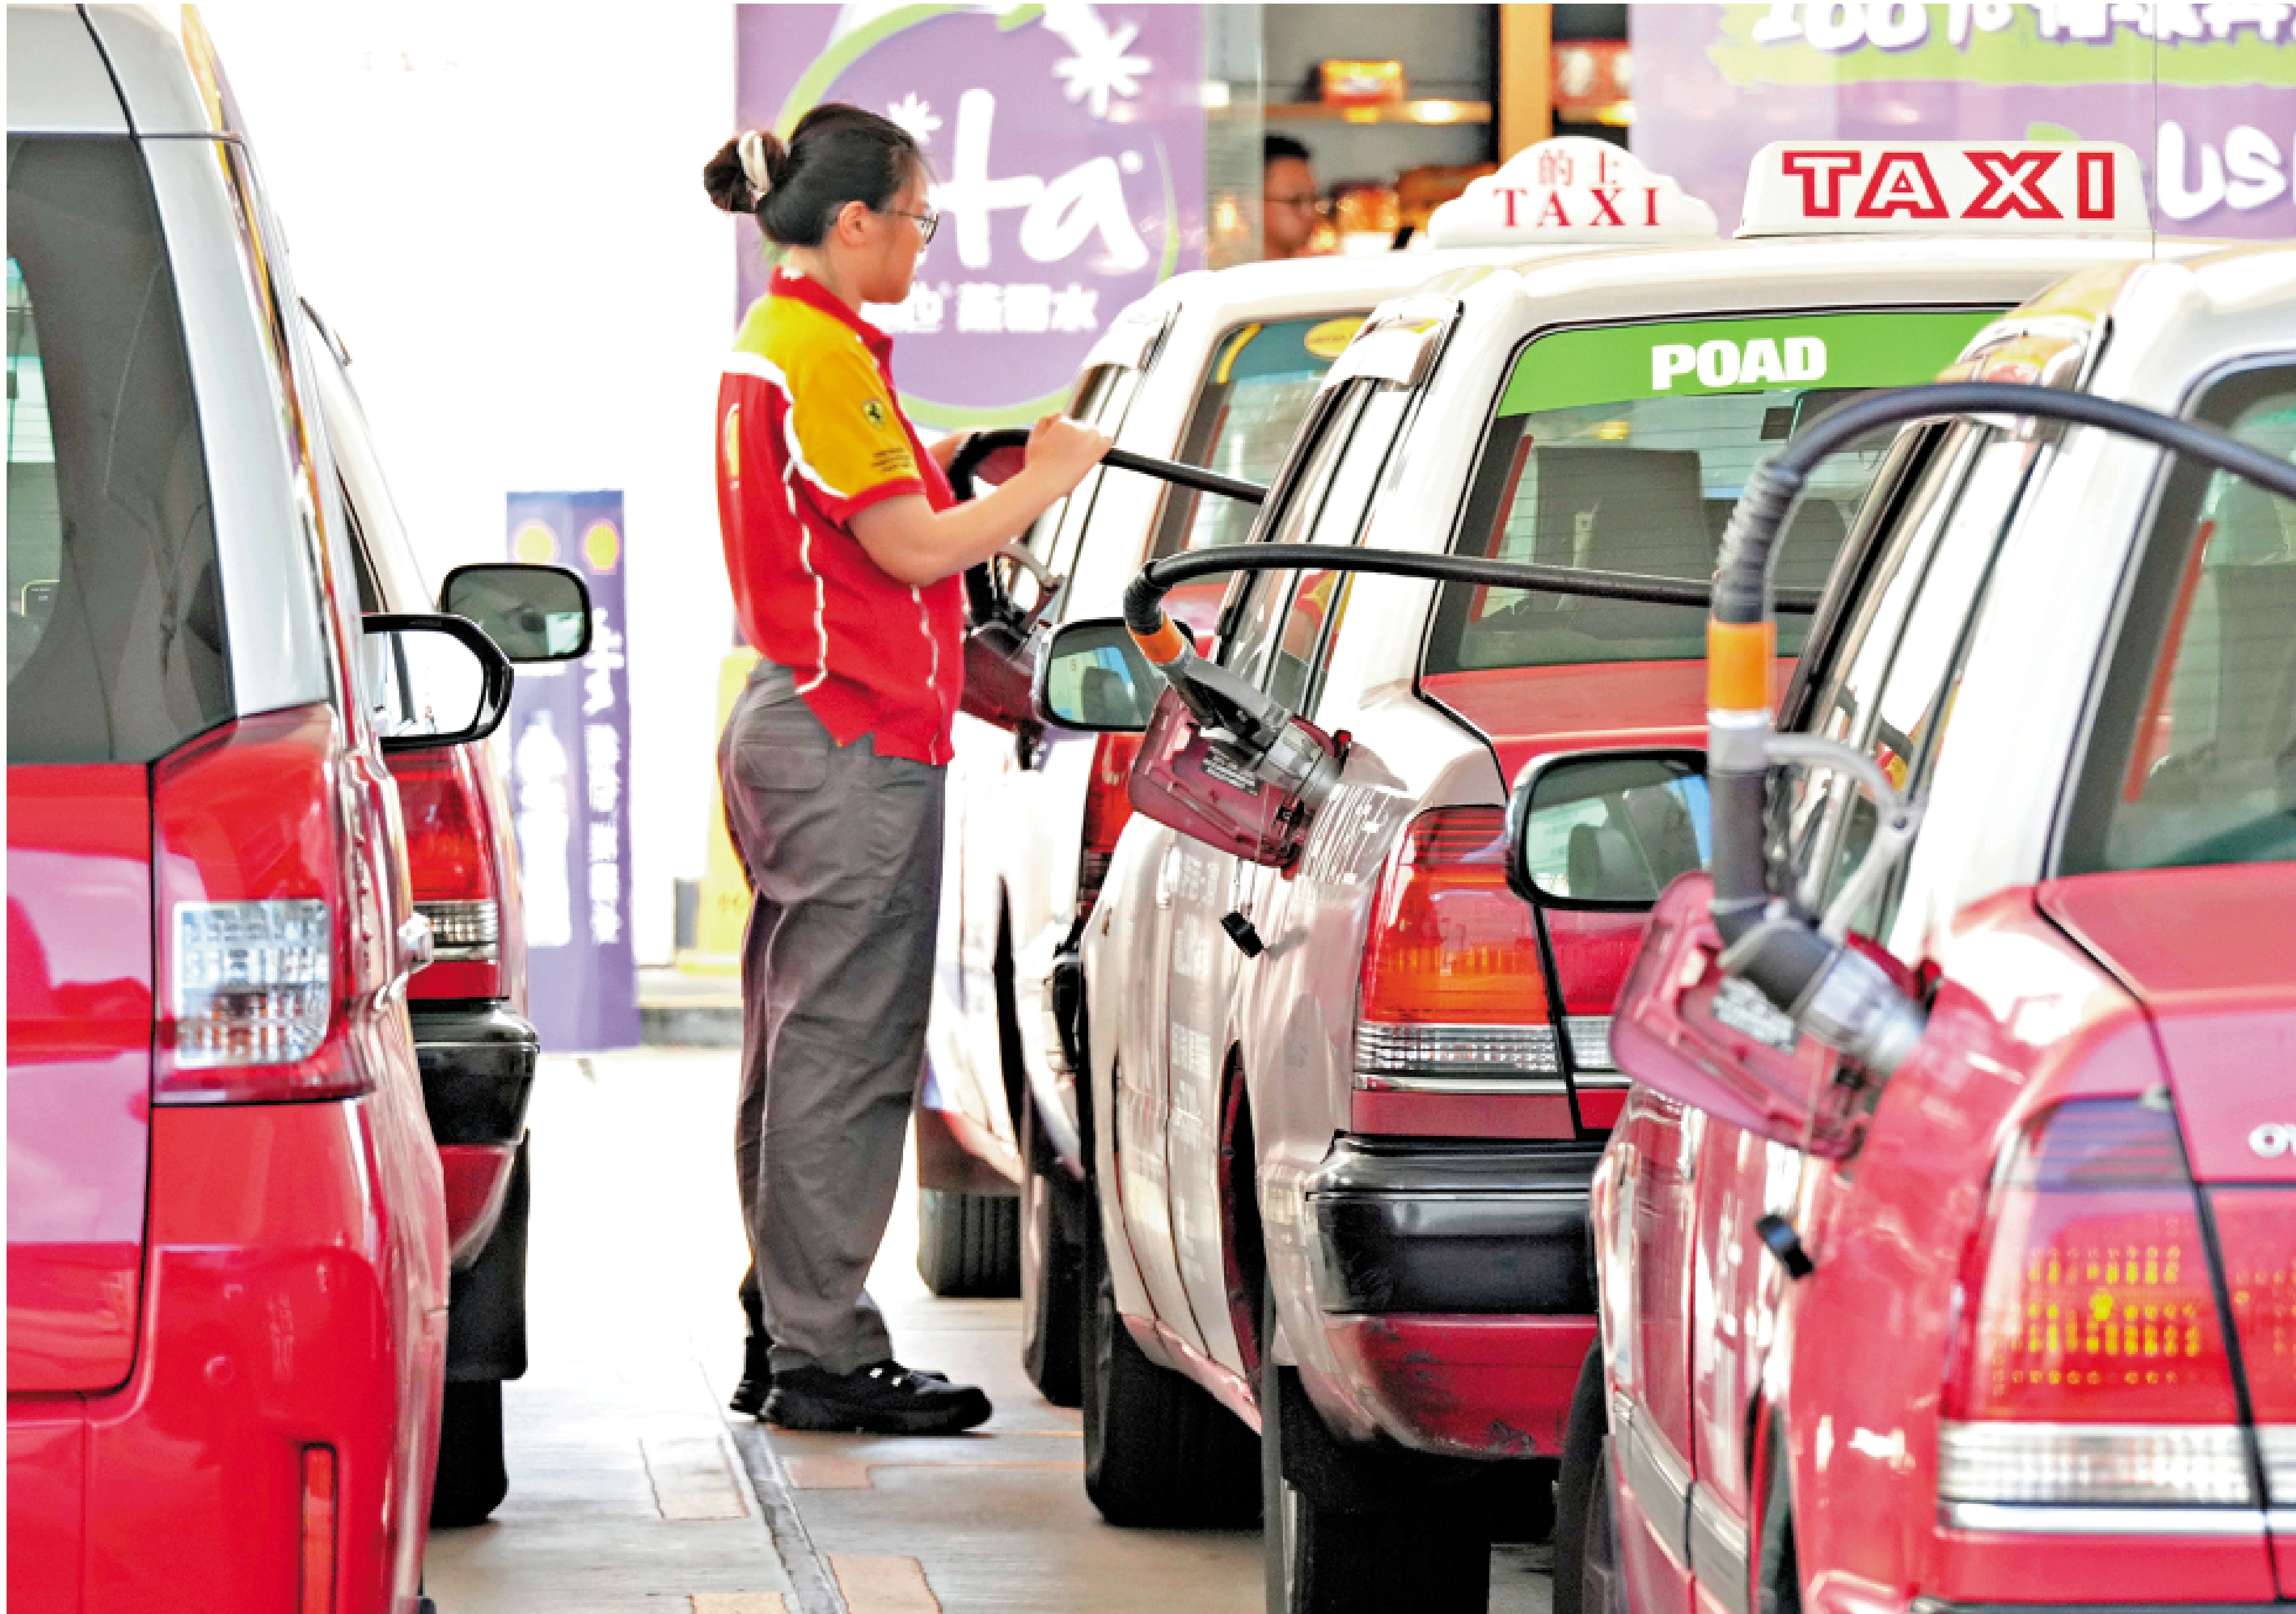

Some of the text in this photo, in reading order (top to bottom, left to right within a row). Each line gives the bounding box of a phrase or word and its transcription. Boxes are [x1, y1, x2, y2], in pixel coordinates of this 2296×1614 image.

[1493, 187, 1661, 227] TAXI
[1782, 150, 2115, 221] TAXI
[1651, 336, 1827, 390] POAD
